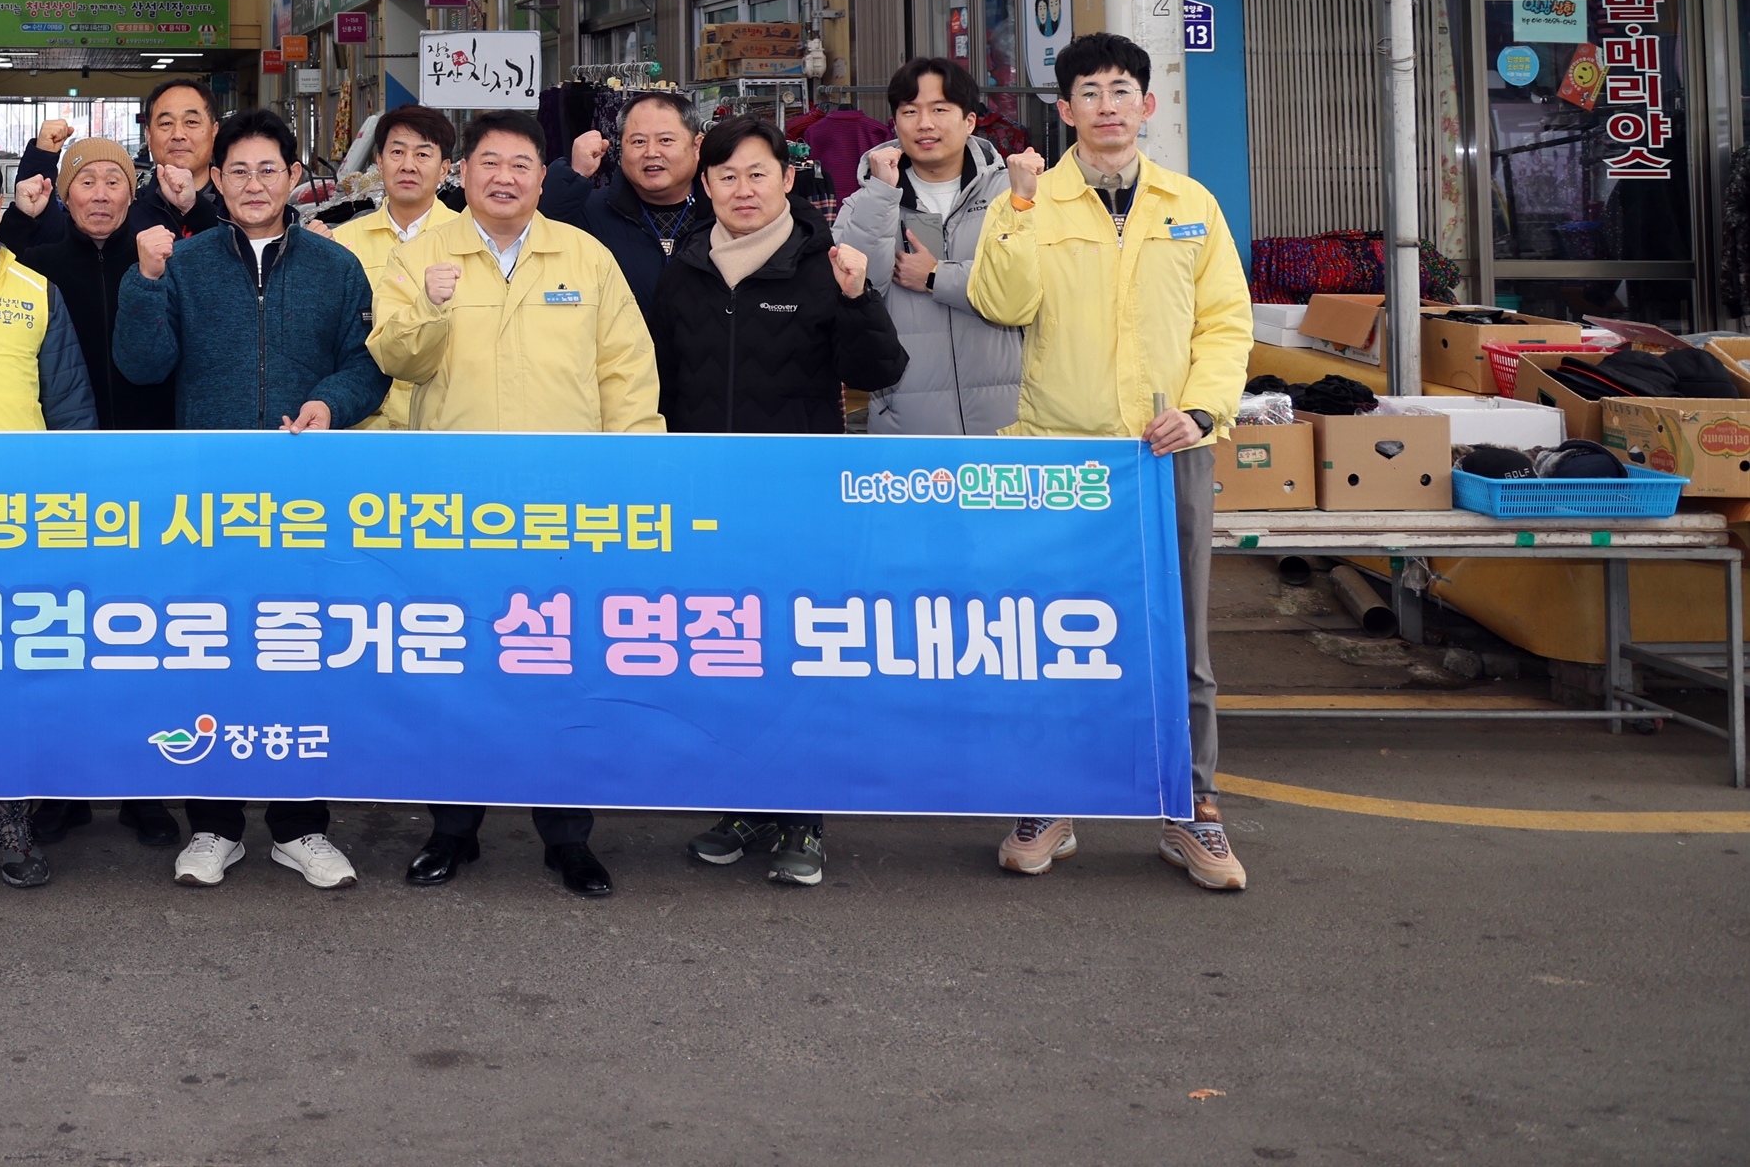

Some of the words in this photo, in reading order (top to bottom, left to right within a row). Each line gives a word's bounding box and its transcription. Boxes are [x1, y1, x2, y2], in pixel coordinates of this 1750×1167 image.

[25, 0, 87, 18] 청년상인과
[89, 2, 126, 16] 함께하는
[32, 23, 46, 31] 수산
[166, 23, 190, 32] 음식점
[1185, 24, 1209, 46] 13
[427, 42, 450, 59] 장흥
[427, 61, 463, 86] 무산
[1504, 466, 1531, 480] GOLF
[161, 493, 328, 549] 시작은
[348, 492, 673, 552] 안전으로부터
[254, 600, 467, 675] 즐거운
[493, 591, 575, 677] 설
[601, 592, 766, 679] 명절
[791, 594, 1124, 682] 보내세요
[223, 721, 331, 762] 장흥군
